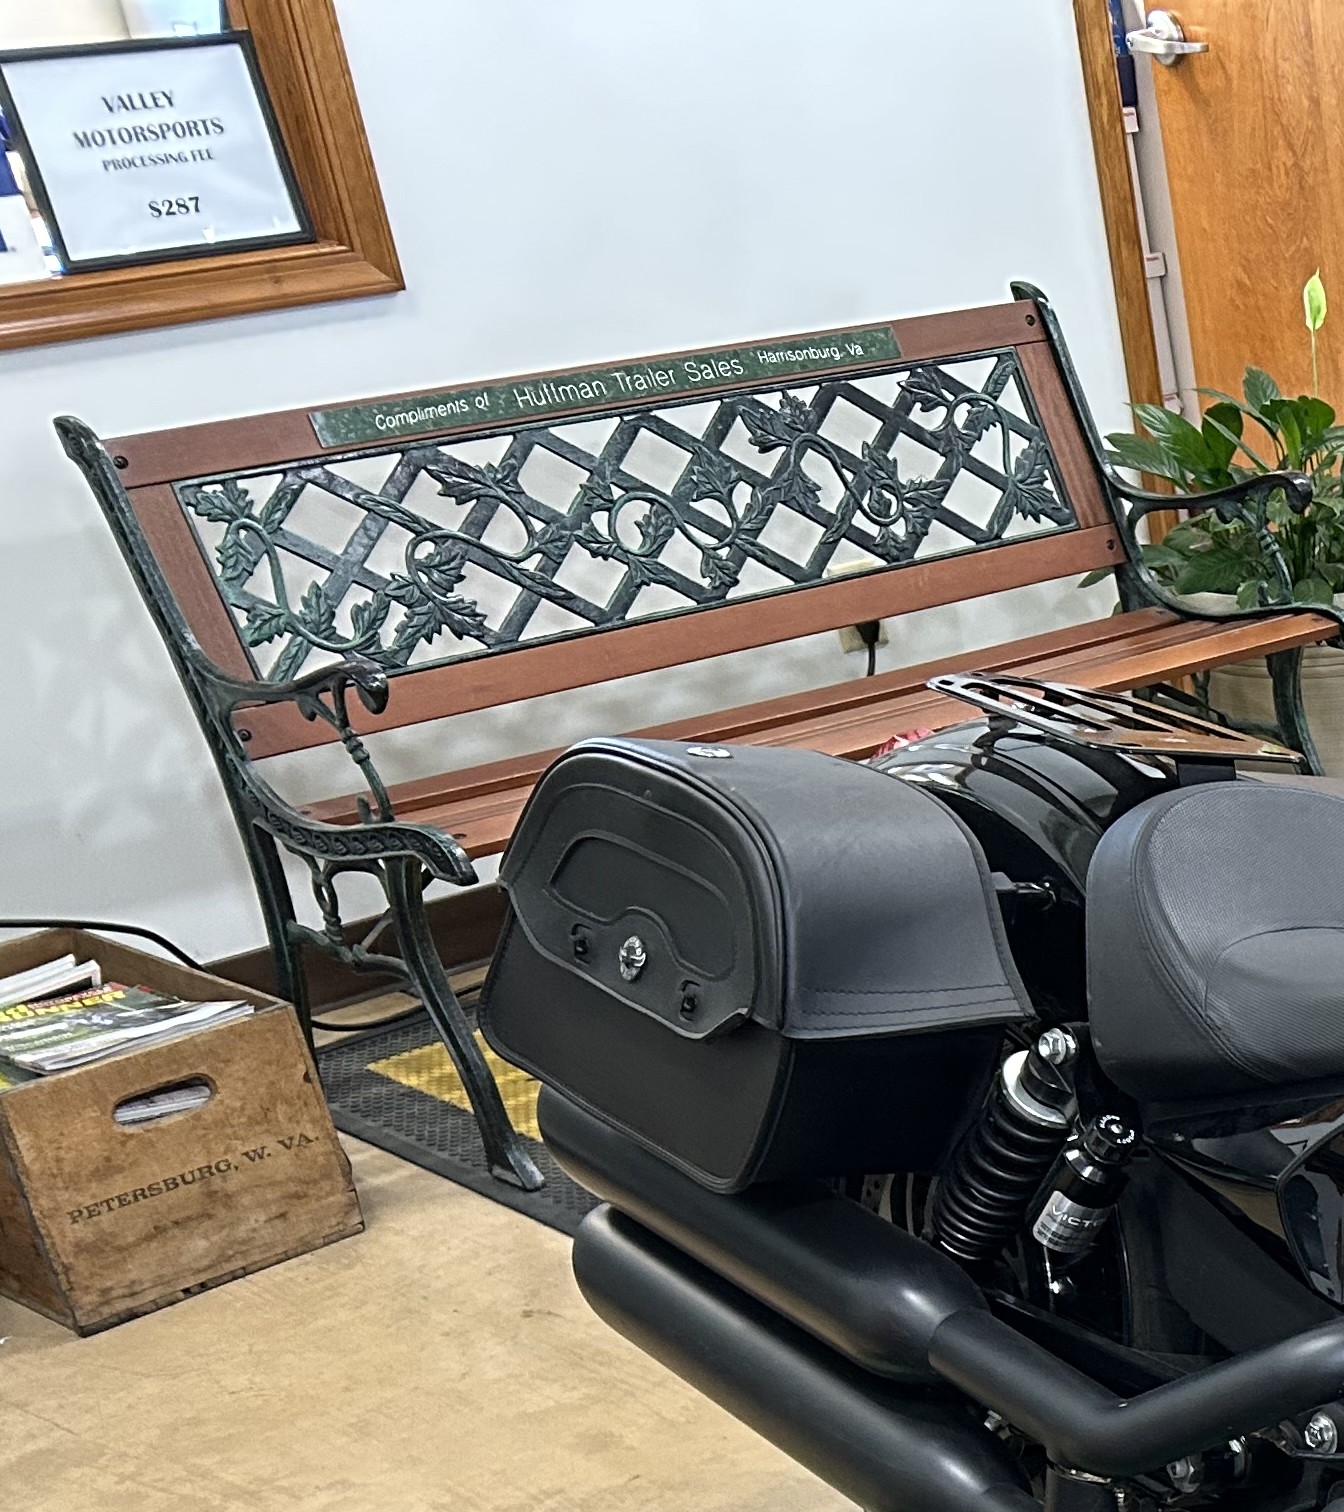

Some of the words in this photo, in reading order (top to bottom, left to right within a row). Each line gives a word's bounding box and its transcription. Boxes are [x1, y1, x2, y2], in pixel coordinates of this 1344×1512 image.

[101, 89, 174, 114] VALLEY
[73, 117, 225, 149] MOTORSPORTS
[102, 151, 188, 172] PROCESSING
[190, 148, 214, 162] FEE
[148, 196, 201, 218] $287
[375, 401, 470, 432] Compliments
[474, 391, 490, 411] of
[512, 380, 608, 409] Huffman
[611, 367, 677, 394] Trailer
[684, 358, 745, 383] Sales
[846, 342, 865, 357] Va
[66, 1158, 240, 1226] PETERSBURG,
[241, 1145, 272, 1163] W.
[277, 1132, 320, 1150] VA.
